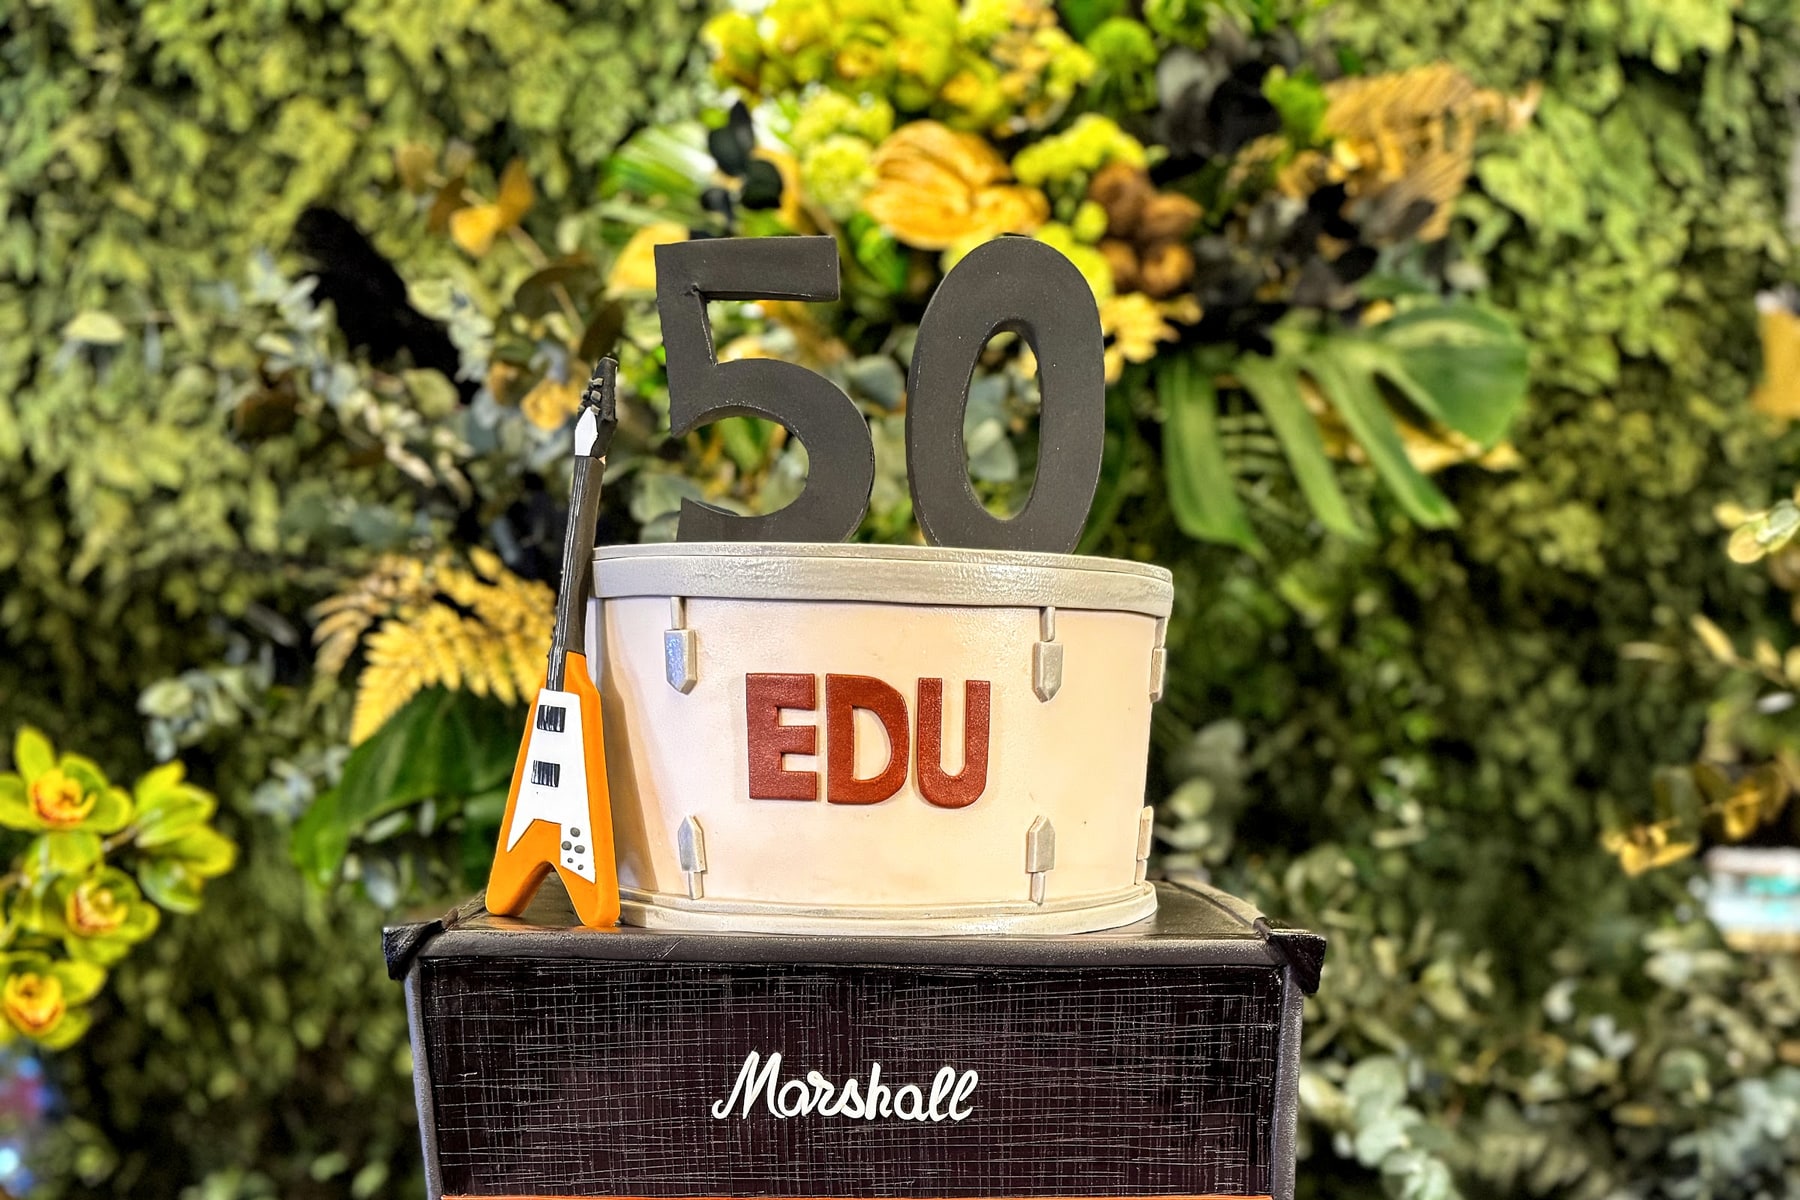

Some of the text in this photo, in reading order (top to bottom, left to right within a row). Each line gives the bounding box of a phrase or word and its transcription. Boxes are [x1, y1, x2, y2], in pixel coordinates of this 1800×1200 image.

[653, 235, 1107, 555] 50
[745, 672, 993, 808] EDU
[711, 1050, 979, 1122] Marshall
